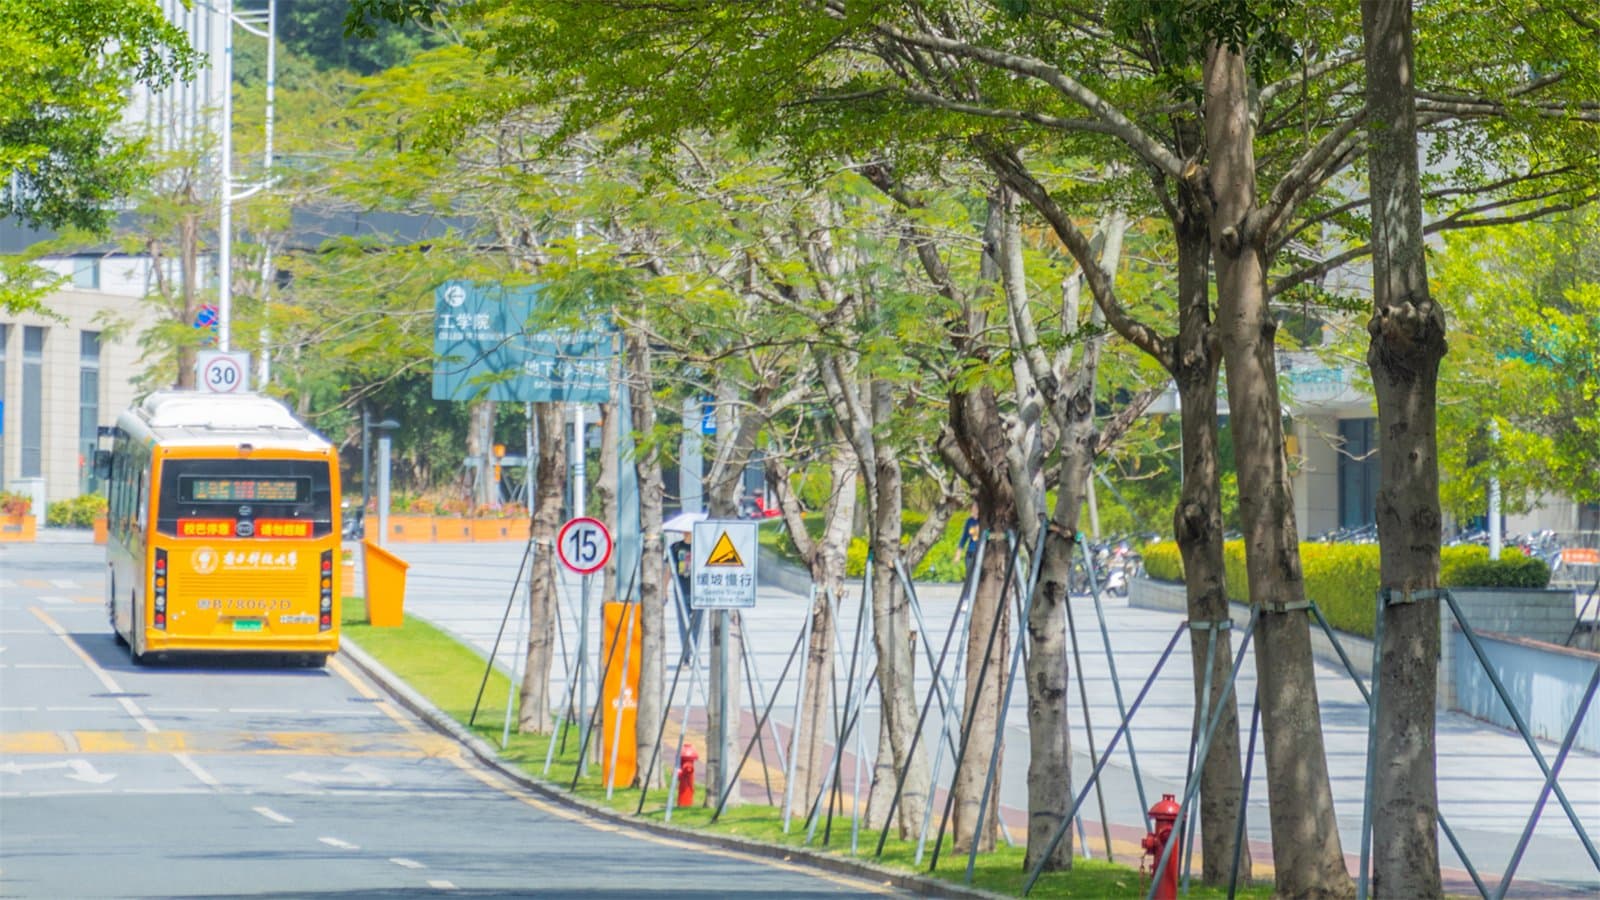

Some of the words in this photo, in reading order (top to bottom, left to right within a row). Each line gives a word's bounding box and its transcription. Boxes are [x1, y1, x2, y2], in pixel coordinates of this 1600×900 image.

[439, 313, 490, 330] 工学院
[211, 366, 236, 385] 30
[525, 360, 607, 378] 地下停车场
[570, 529, 597, 562] 15
[696, 573, 752, 587] 缓坡慢行
